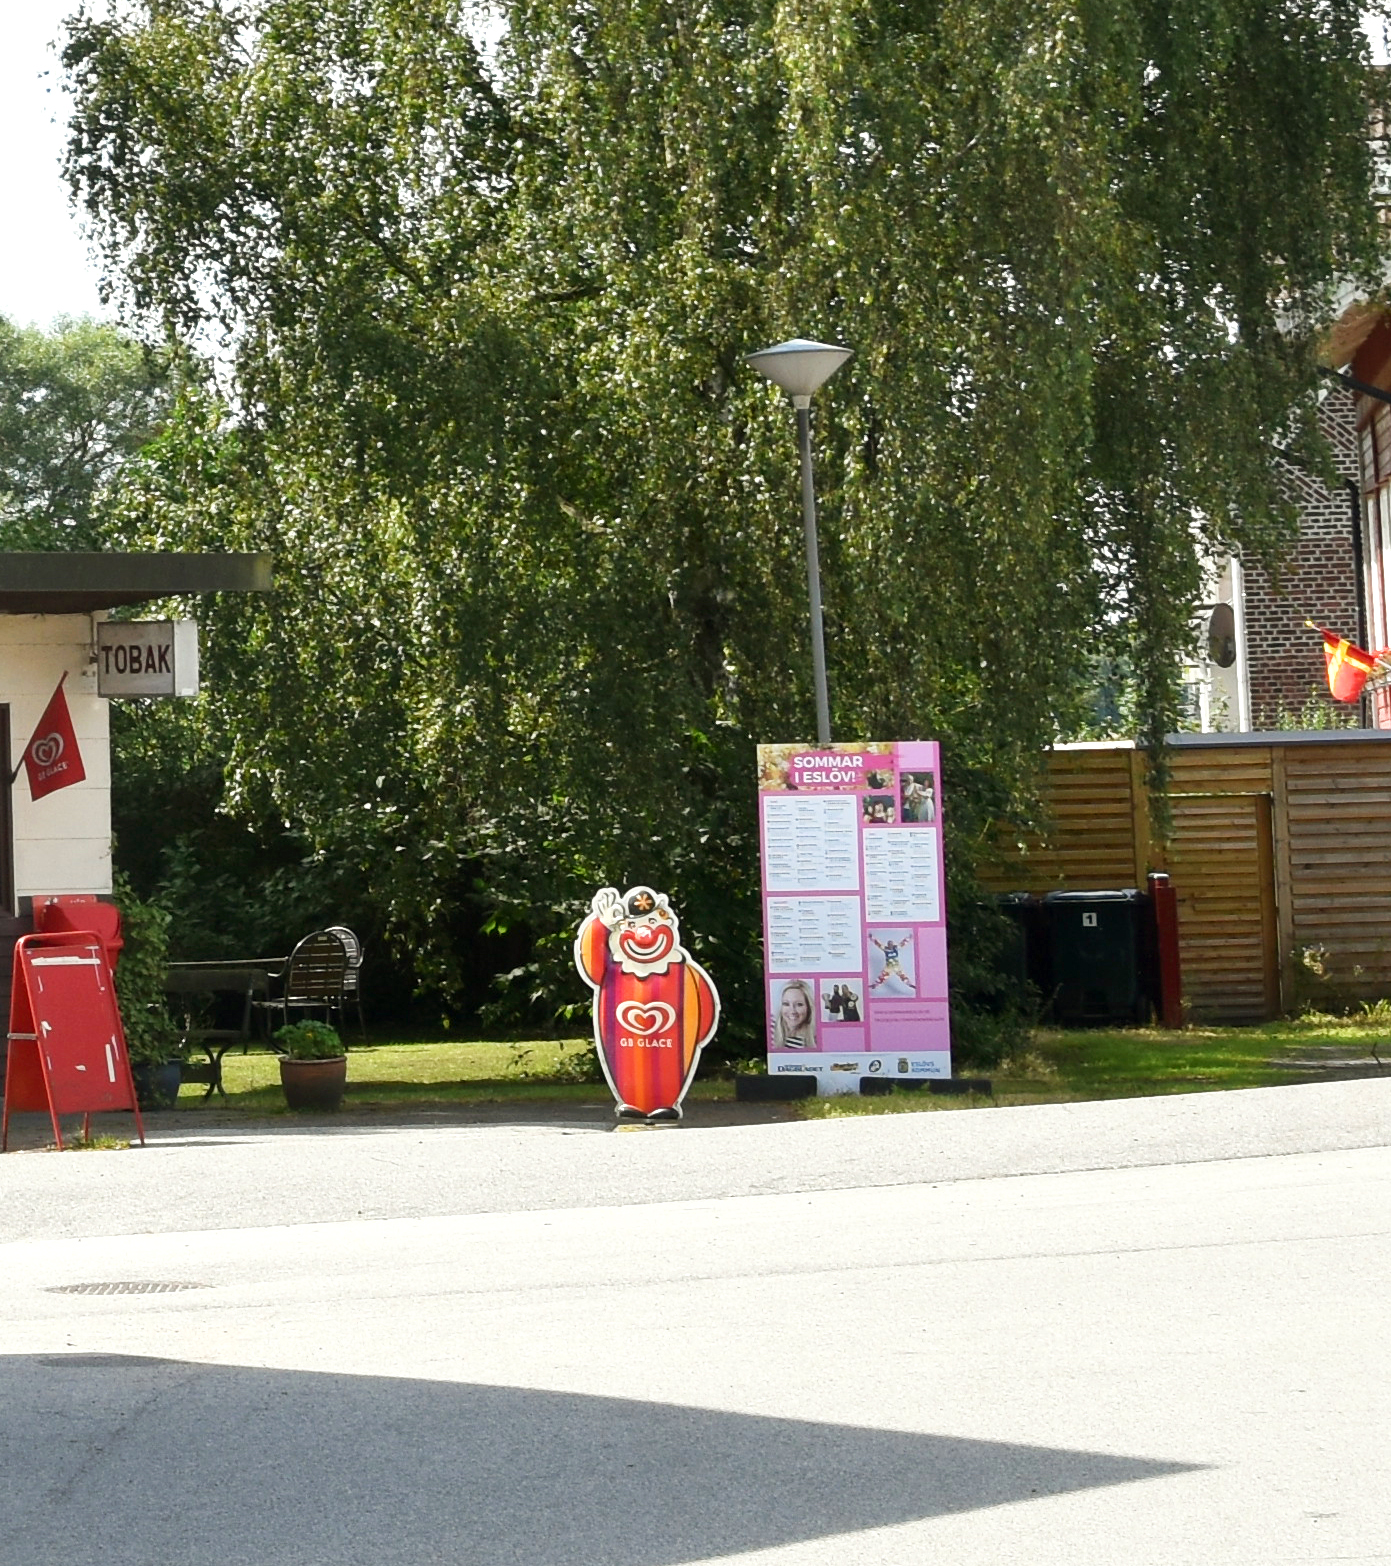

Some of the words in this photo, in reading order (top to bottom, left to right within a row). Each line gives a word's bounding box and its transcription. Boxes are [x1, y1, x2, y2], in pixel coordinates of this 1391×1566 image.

[101, 644, 172, 675] TOBAK
[793, 755, 863, 768] SOMMAR
[794, 771, 799, 783] I
[803, 768, 856, 783] ESLÖV!
[620, 1037, 634, 1047] GB
[637, 1038, 673, 1048] GLACE
